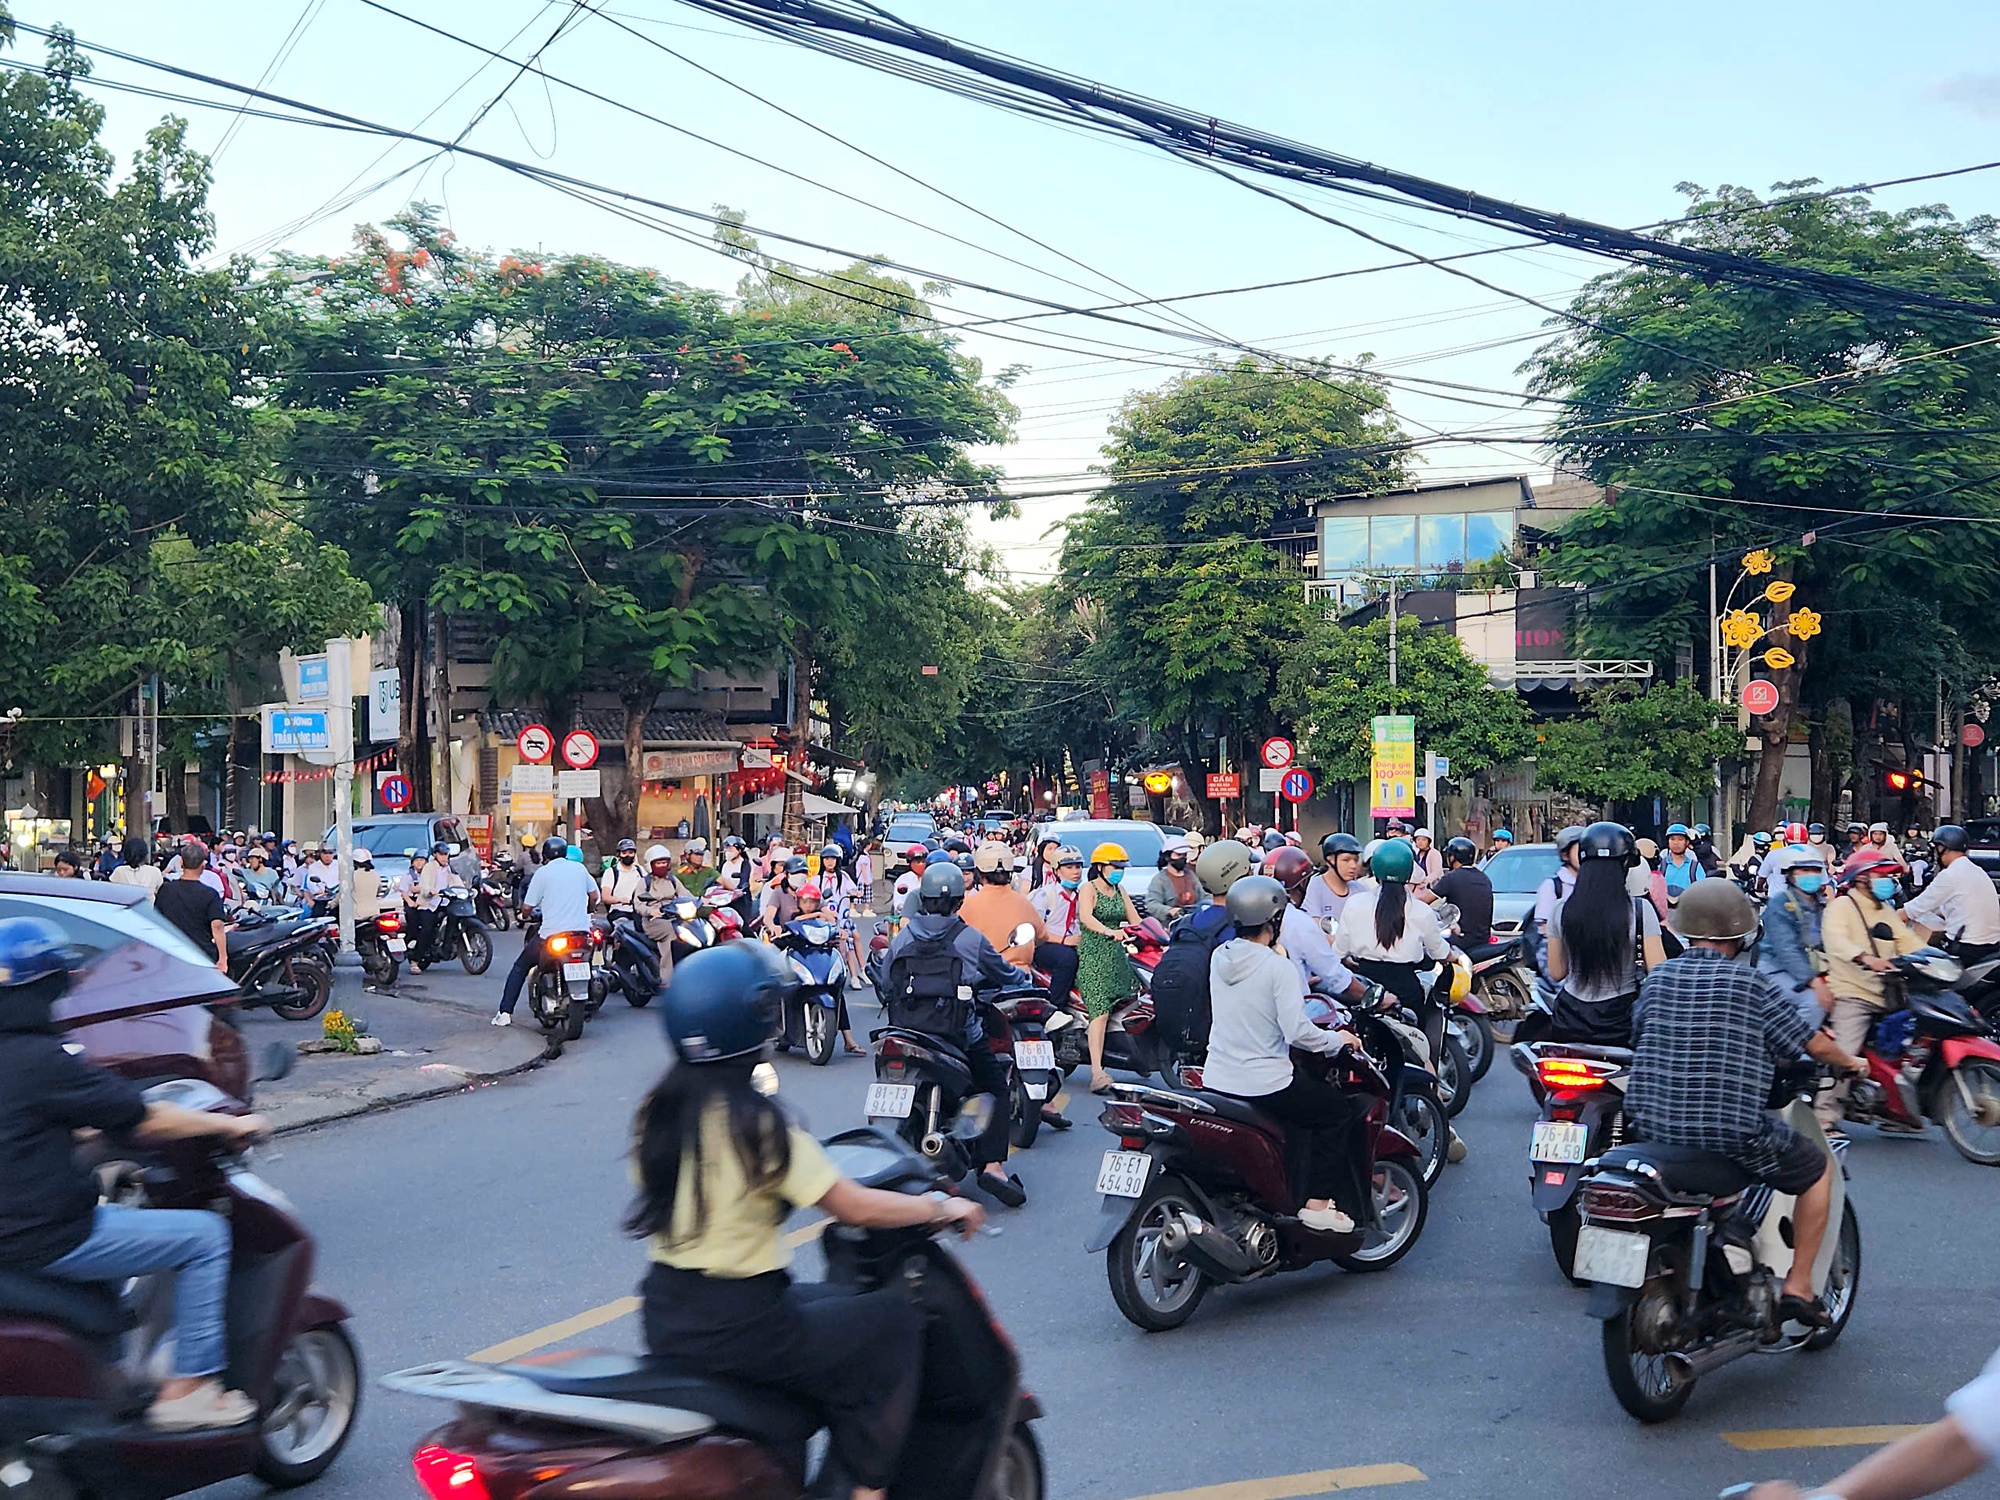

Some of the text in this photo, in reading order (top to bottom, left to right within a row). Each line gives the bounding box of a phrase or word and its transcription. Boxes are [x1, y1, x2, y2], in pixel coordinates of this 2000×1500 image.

[874, 1086, 908, 1100] 81-T3
[871, 1101, 904, 1113] 9441
[1541, 1127, 1578, 1143] 76-AA
[1534, 1143, 1580, 1160] 114.58
[1109, 1155, 1141, 1174] 76-E1
[1099, 1174, 1142, 1194] 454.90
